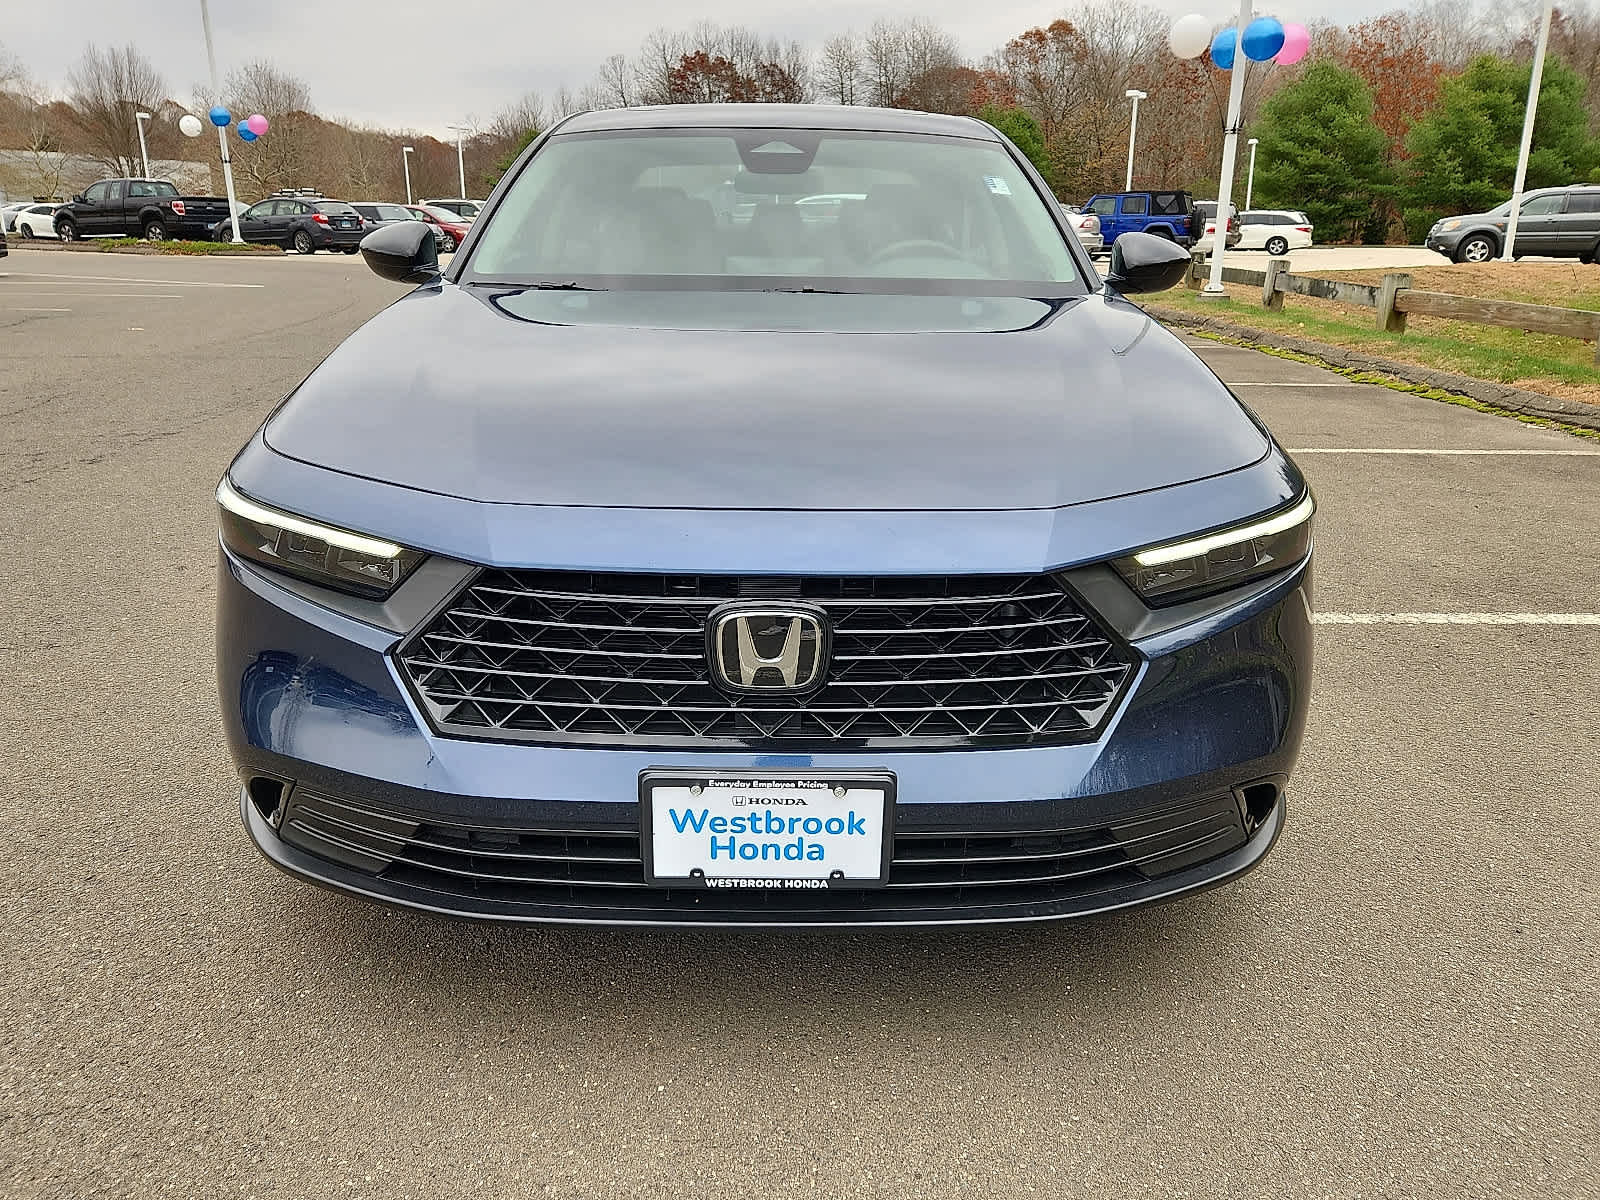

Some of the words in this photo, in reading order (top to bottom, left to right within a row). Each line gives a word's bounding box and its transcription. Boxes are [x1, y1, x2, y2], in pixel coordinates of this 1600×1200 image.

[708, 779, 751, 789] Everyday
[752, 780, 796, 790] Employee
[797, 781, 829, 790] Pricing
[748, 797, 808, 806] HONDA
[669, 808, 866, 835] Westbrook
[710, 835, 825, 861] Honda
[705, 878, 782, 888] WESTBROOK
[784, 879, 829, 889] HONDA
